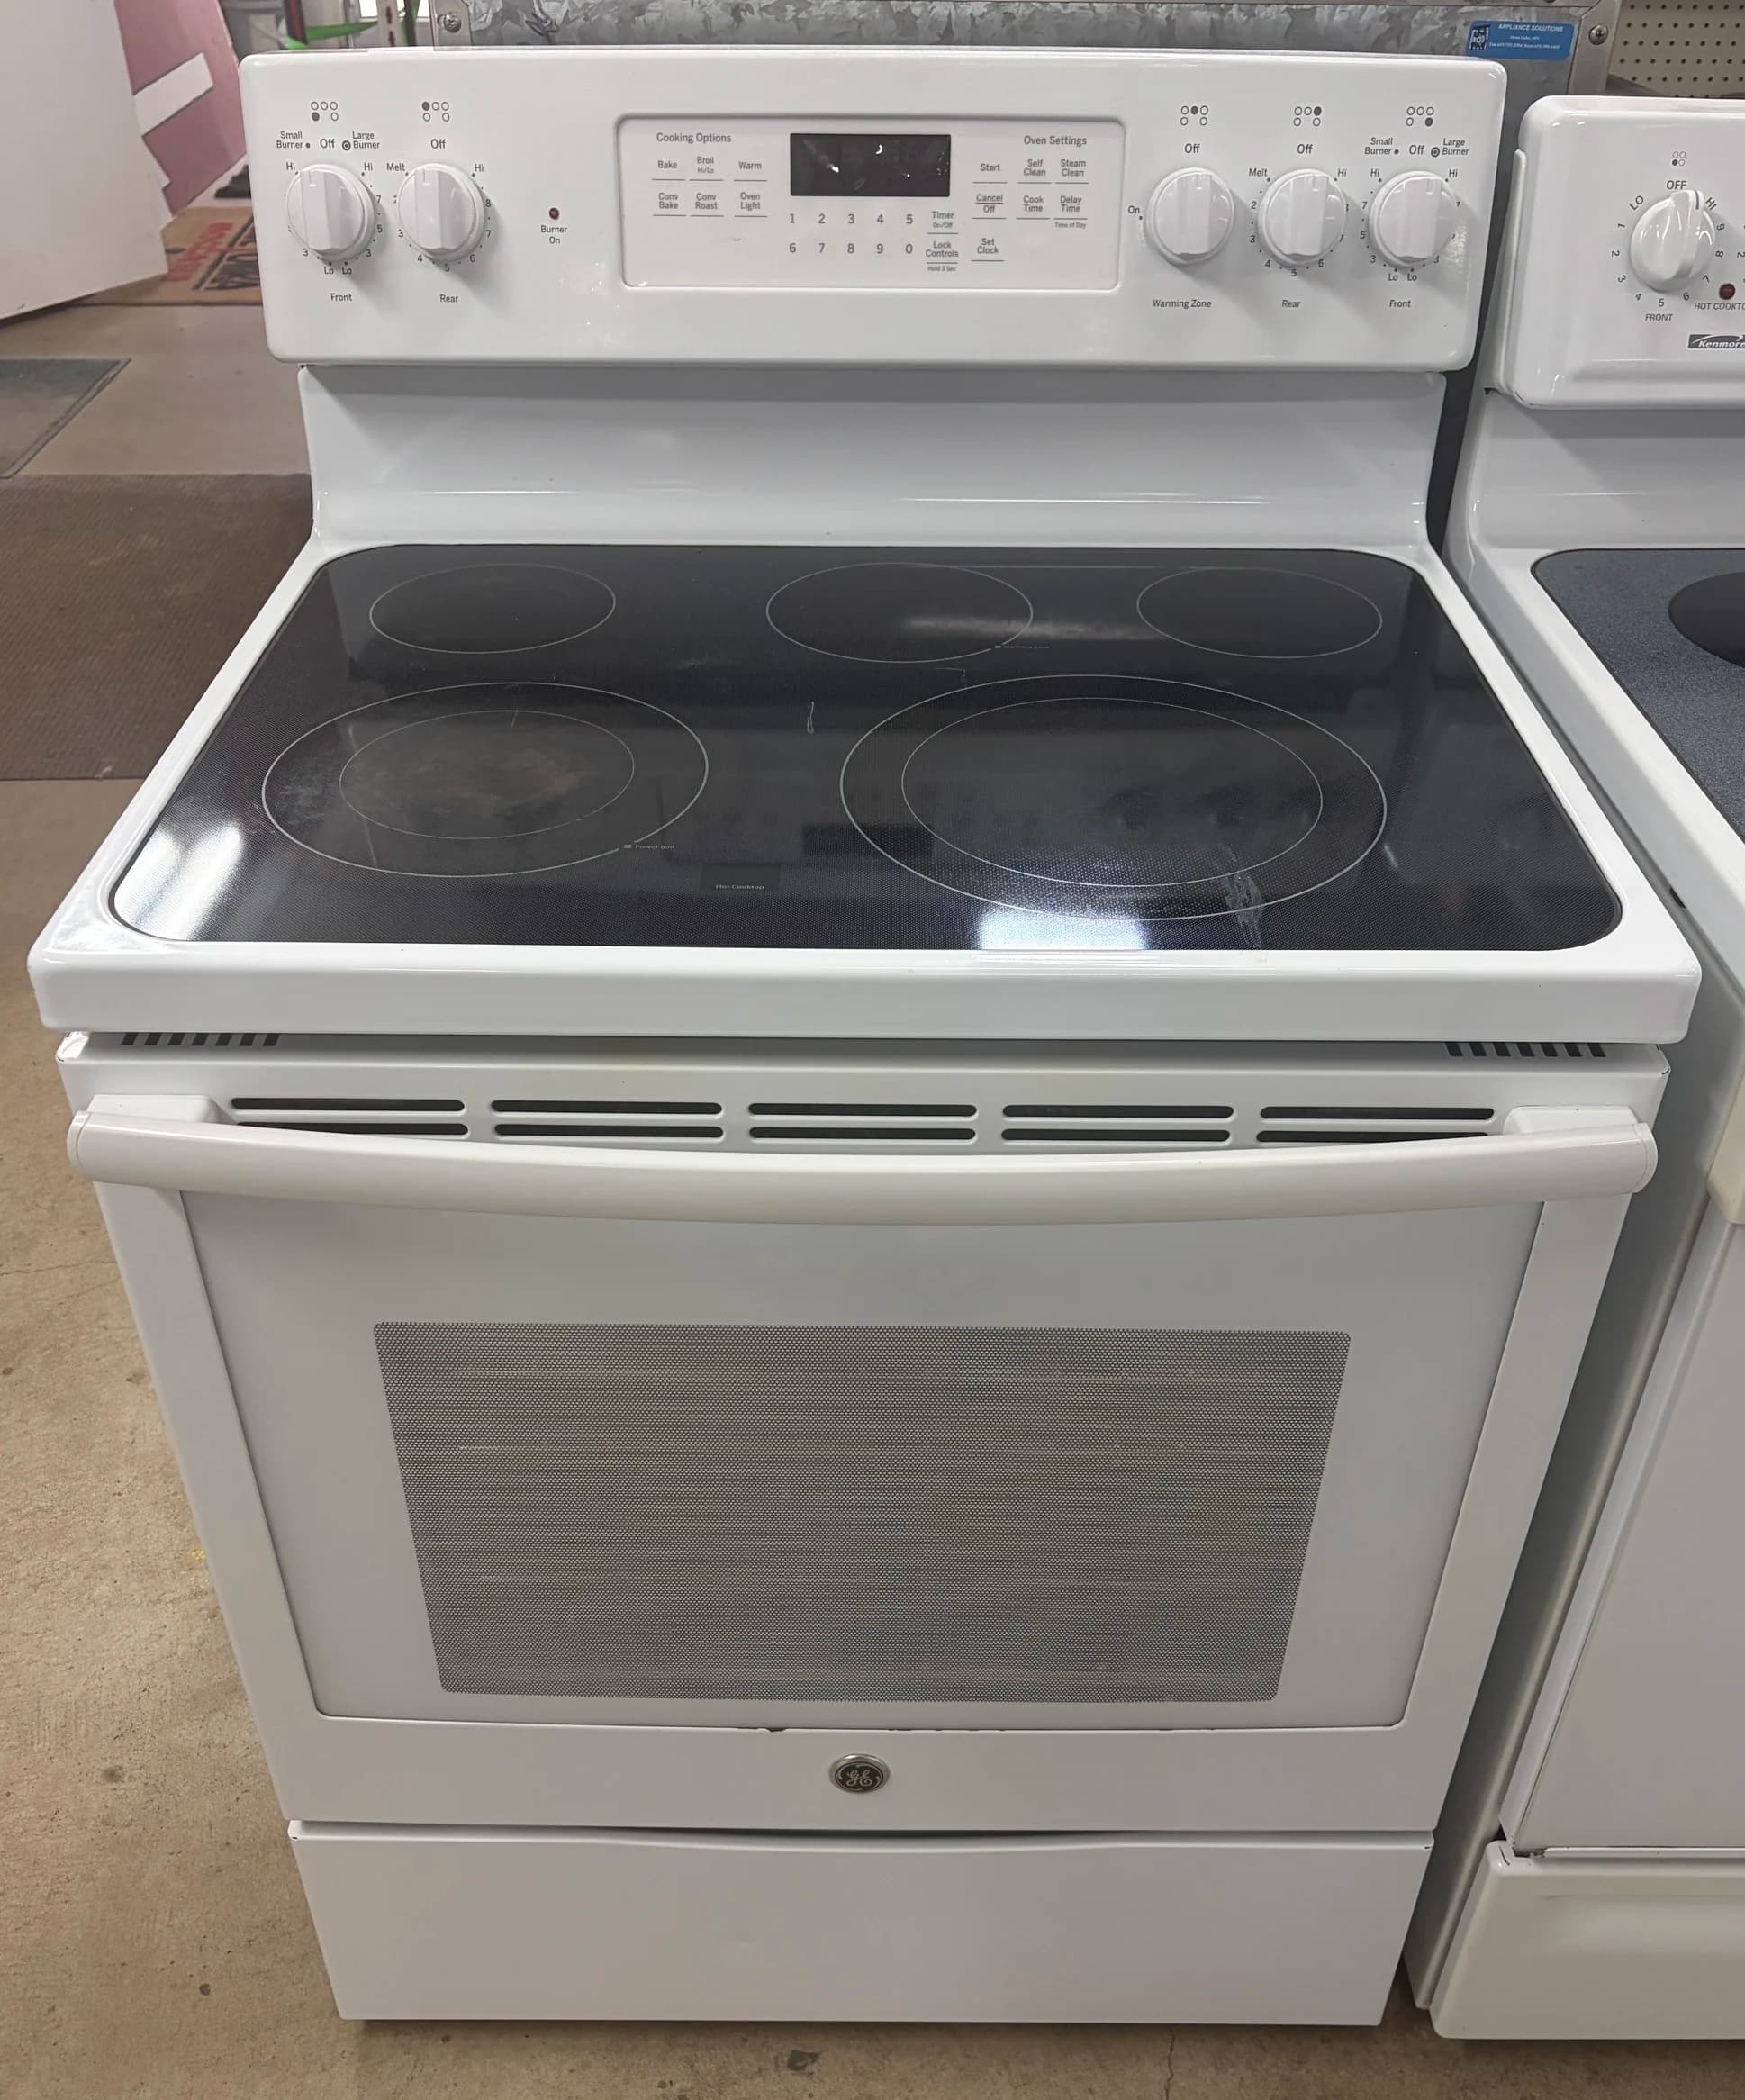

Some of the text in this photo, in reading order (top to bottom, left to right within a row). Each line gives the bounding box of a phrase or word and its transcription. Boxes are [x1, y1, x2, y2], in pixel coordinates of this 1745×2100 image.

[280, 131, 303, 140] Small
[352, 131, 375, 140] Large
[656, 132, 731, 144] Cooking Options
[276, 140, 303, 149] Burner
[320, 139, 336, 149] Off
[353, 141, 380, 149] Burner
[430, 139, 447, 149] Off
[1024, 136, 1087, 147] Oven Settings
[1442, 138, 1465, 147] Large
[1184, 143, 1200, 153] Off
[1297, 144, 1313, 154] Off
[1364, 147, 1392, 155] Burner
[1409, 145, 1424, 155] Off
[1442, 148, 1469, 156] Burner
[657, 160, 677, 168] Bake
[697, 156, 714, 164] Broil
[1027, 159, 1044, 167] Self
[1061, 159, 1086, 167] Steam
[285, 162, 295, 170] Hi
[364, 162, 373, 171] Hi
[386, 163, 405, 171] Melt
[475, 164, 484, 172] Hi
[738, 161, 762, 169] Warm
[981, 163, 1000, 171] Start
[1023, 168, 1046, 177] Clean
[1062, 168, 1084, 177] Clean
[1249, 168, 1268, 177] Melt
[1337, 168, 1346, 177] Hi
[1370, 168, 1379, 177] Hi
[1449, 169, 1458, 177] Hi
[1666, 180, 1686, 190] OFF
[375, 195, 381, 203] 7
[658, 192, 678, 200] Conv
[696, 193, 716, 201] Conv
[740, 192, 760, 200] Oven
[976, 194, 1003, 202] Cancel
[1023, 195, 1044, 204] Cook
[1060, 195, 1082, 205] Delay
[485, 199, 492, 207] 8
[659, 201, 678, 209] Bake
[695, 201, 718, 210] Roast
[740, 202, 761, 211] Light
[1251, 201, 1257, 209] 2
[1629, 195, 1644, 211] LO
[1705, 197, 1717, 211] HI
[983, 205, 995, 213] Off
[1061, 204, 1080, 213] Time
[1127, 205, 1140, 214] On
[790, 213, 913, 224] 1 2 3 4 5
[931, 211, 954, 220] Timer
[376, 224, 383, 233] 5
[540, 225, 567, 233] Burner
[486, 230, 492, 238] 7
[1360, 231, 1365, 239] 5
[981, 238, 995, 246] Set
[1250, 235, 1256, 243] 3
[790, 243, 913, 254] 6 7 8 9 0
[933, 240, 952, 249] Lock
[366, 249, 372, 258] 3
[926, 249, 958, 258] Controls
[977, 246, 999, 254] Clock
[417, 254, 423, 262] 4
[469, 254, 475, 262] 6
[1370, 255, 1376, 263] 3
[1265, 259, 1271, 267] 4
[1318, 259, 1324, 267] 6
[324, 267, 334, 275] Lo
[342, 267, 352, 275] Lo
[445, 264, 450, 272] 5
[1388, 273, 1398, 281] Lo
[1407, 273, 1417, 281] Lo
[1702, 275, 1710, 283] 7
[330, 293, 352, 302] Front
[439, 294, 459, 303] Rear
[1635, 293, 1642, 301] 4
[1683, 293, 1690, 301] 6
[1153, 299, 1211, 309] Warming Zone
[1282, 300, 1301, 308] Rear
[1389, 300, 1411, 308] Front
[1659, 298, 1665, 307] 5
[1645, 313, 1673, 321] FRONT
[1698, 340, 1745, 348] Kenmore
